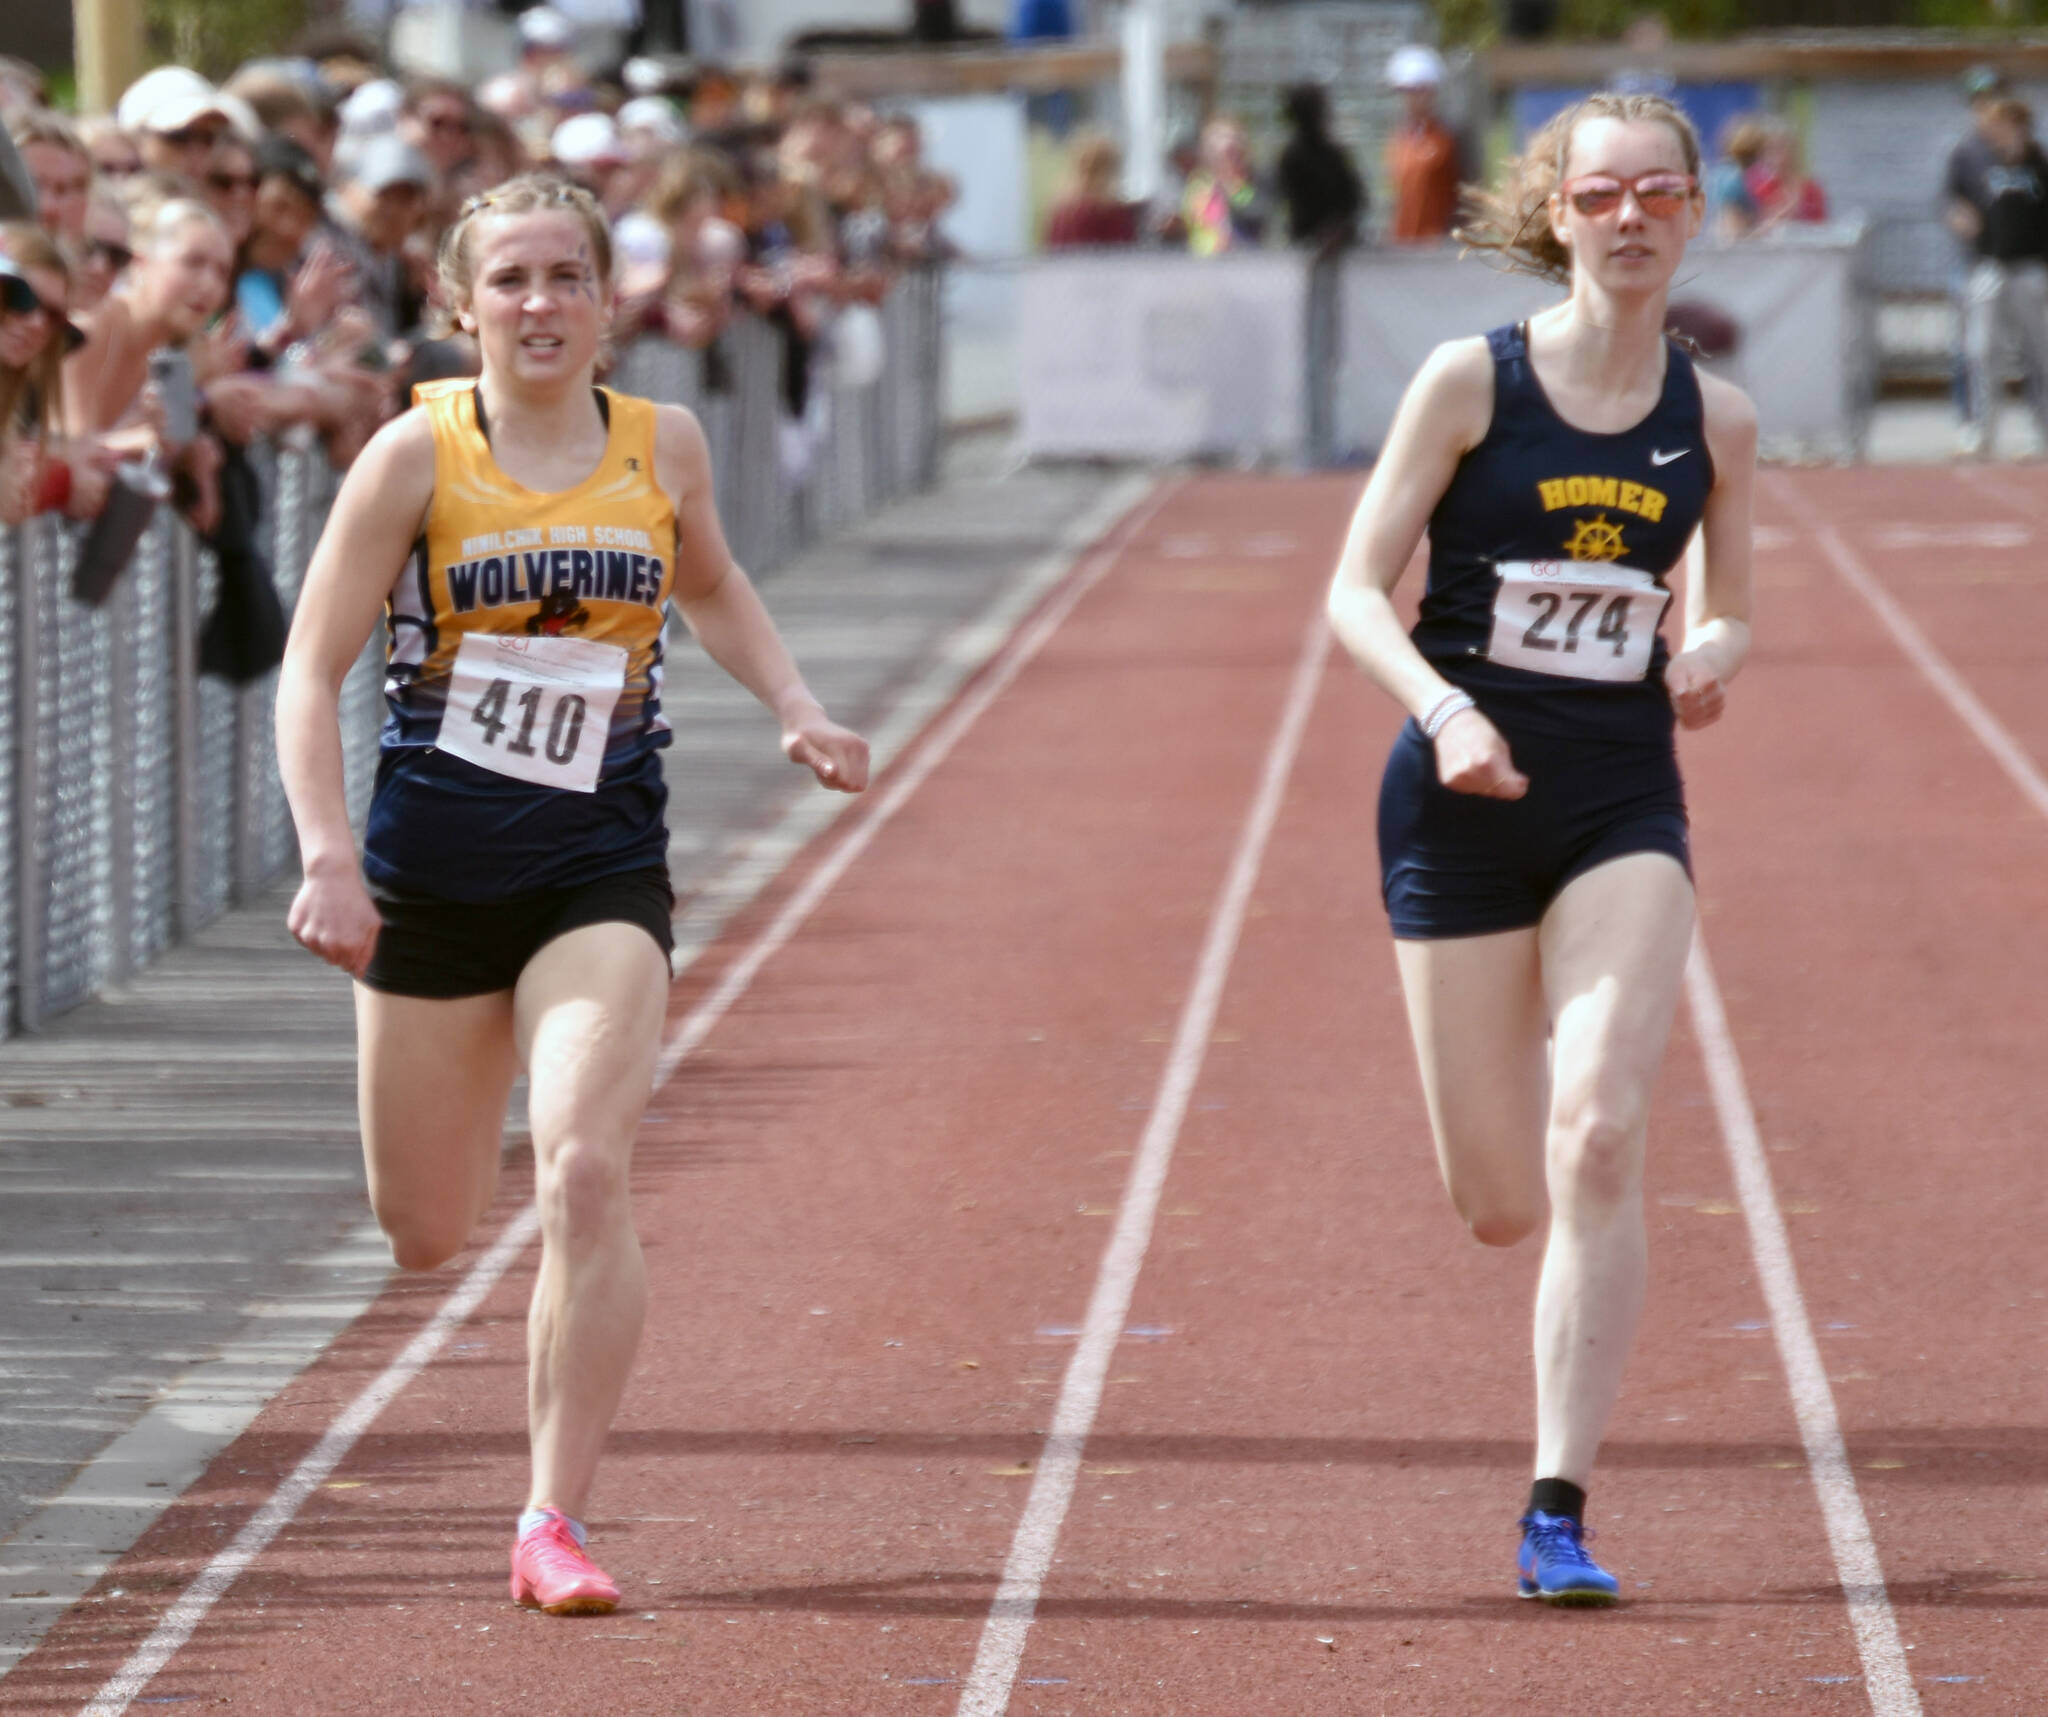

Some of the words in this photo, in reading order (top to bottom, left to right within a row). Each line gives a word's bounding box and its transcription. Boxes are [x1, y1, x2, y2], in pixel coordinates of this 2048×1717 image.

[1537, 475, 1668, 523] HOMER
[548, 525, 588, 544] HIGH
[593, 526, 654, 551] SCHOOL
[446, 549, 665, 615] WOLVERINES
[1530, 561, 1561, 577] GCI
[1521, 592, 1633, 658] 274
[471, 677, 586, 766] 410
